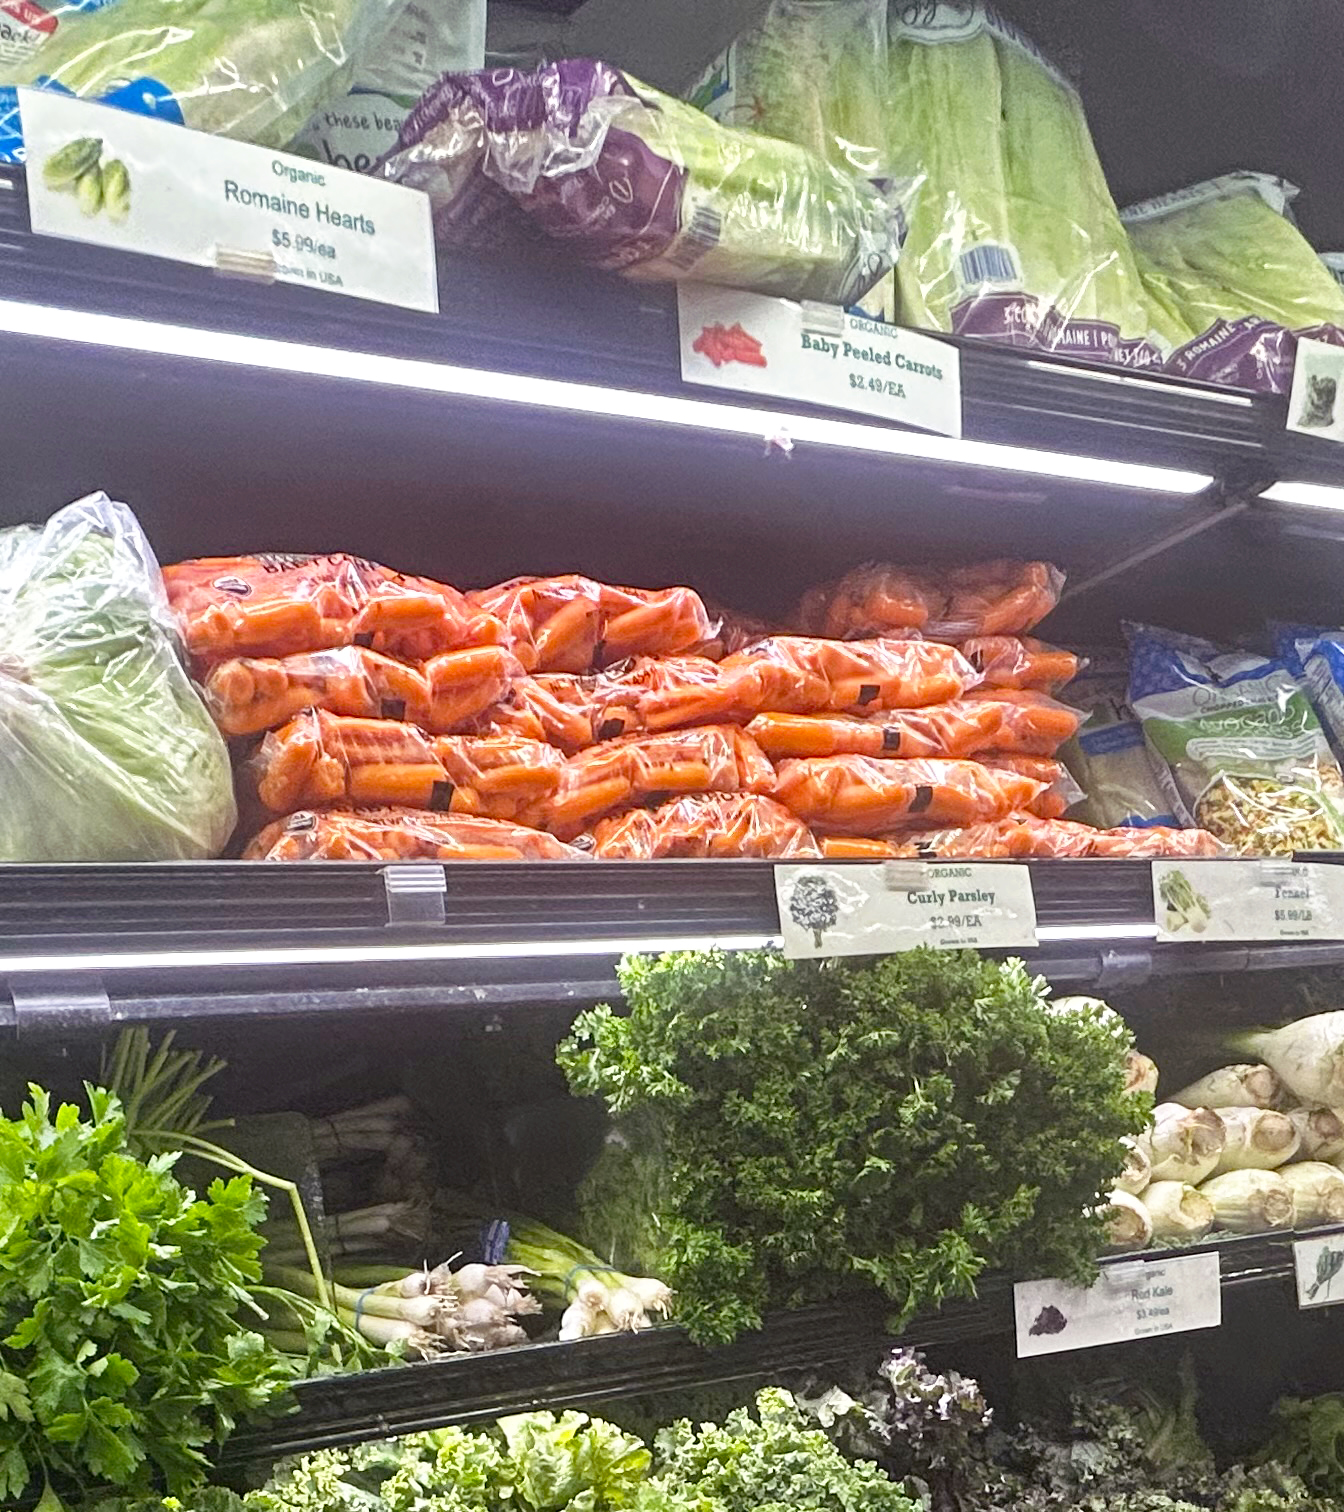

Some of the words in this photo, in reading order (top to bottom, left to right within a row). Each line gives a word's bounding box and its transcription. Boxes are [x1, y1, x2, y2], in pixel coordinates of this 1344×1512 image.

[325, 112, 370, 131] these
[271, 159, 326, 187] Organic
[224, 179, 310, 219] Romaine
[315, 201, 376, 236] Hearts
[319, 272, 344, 287] USA
[849, 317, 899, 340] ORGANIC
[1184, 321, 1237, 361] ROMAINE
[801, 332, 839, 359] Baby
[842, 340, 892, 367] Peeled
[895, 353, 944, 381] Carrots
[848, 372, 907, 399] $2.49/EA
[907, 892, 946, 907] Curly
[949, 890, 996, 905] Parsley
[1152, 1285, 1173, 1298] Kale
